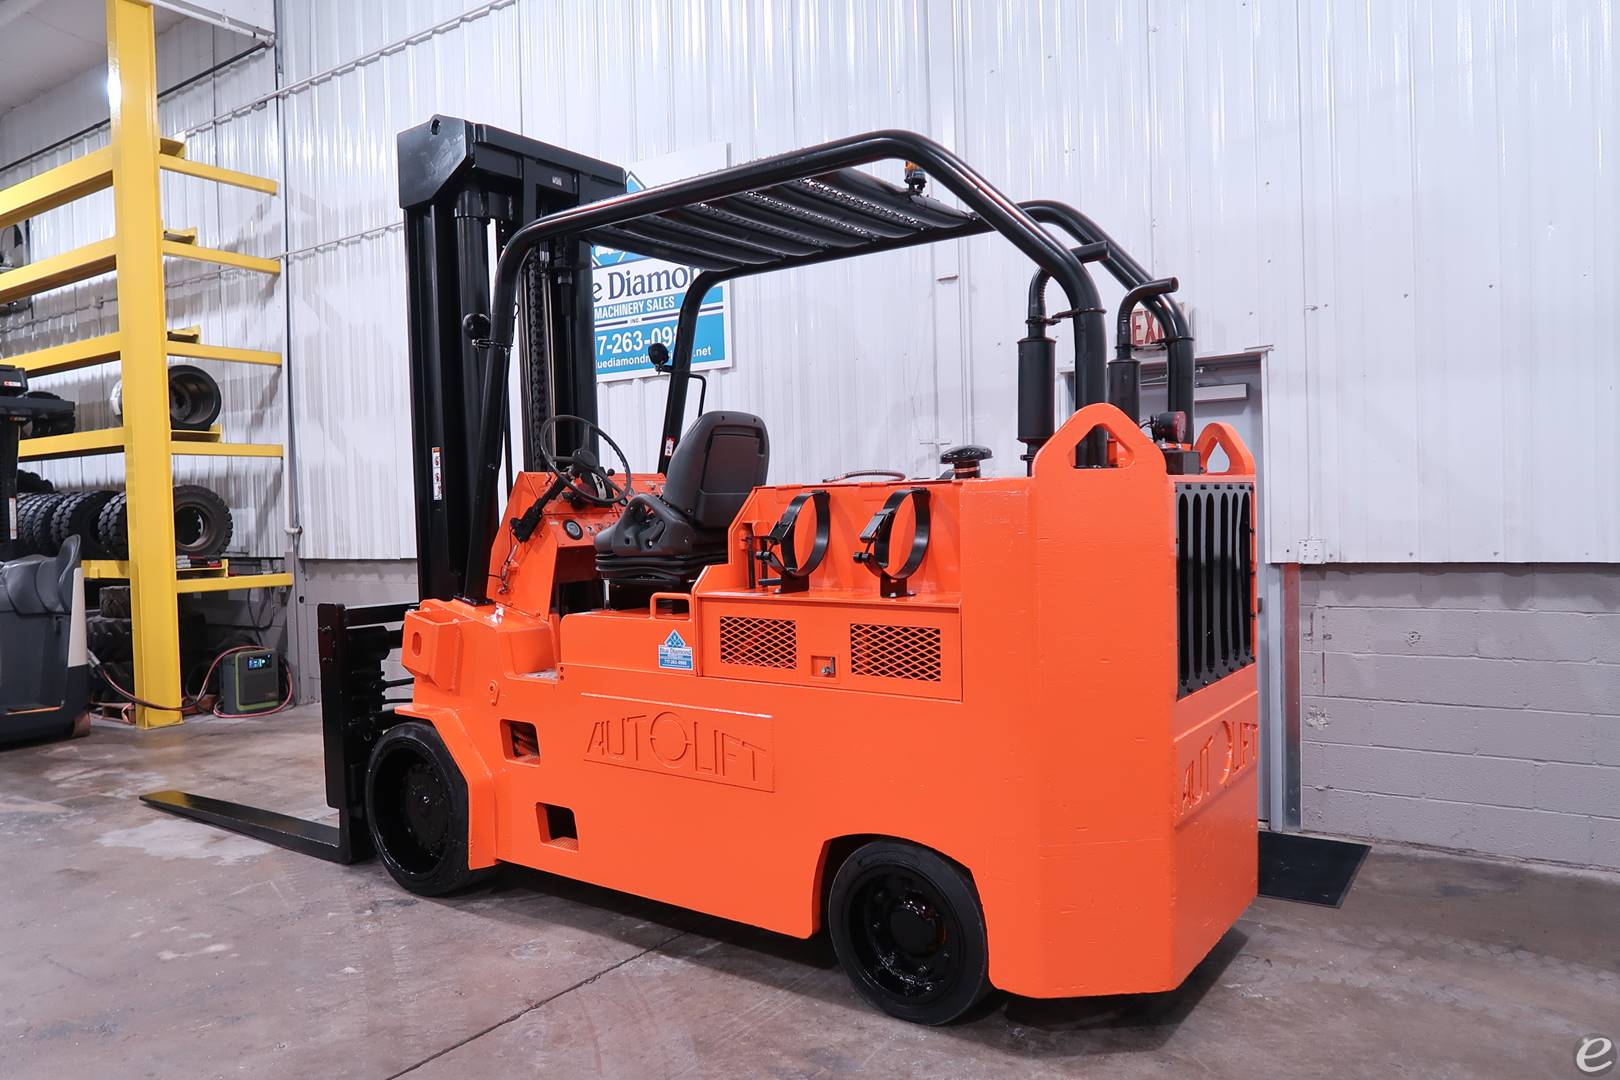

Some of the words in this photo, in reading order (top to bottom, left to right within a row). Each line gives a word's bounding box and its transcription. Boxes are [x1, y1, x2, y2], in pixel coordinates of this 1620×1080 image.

[594, 302, 646, 320] MACHINERY
[646, 296, 675, 313] SALES
[587, 711, 768, 784] AUTOLIFT
